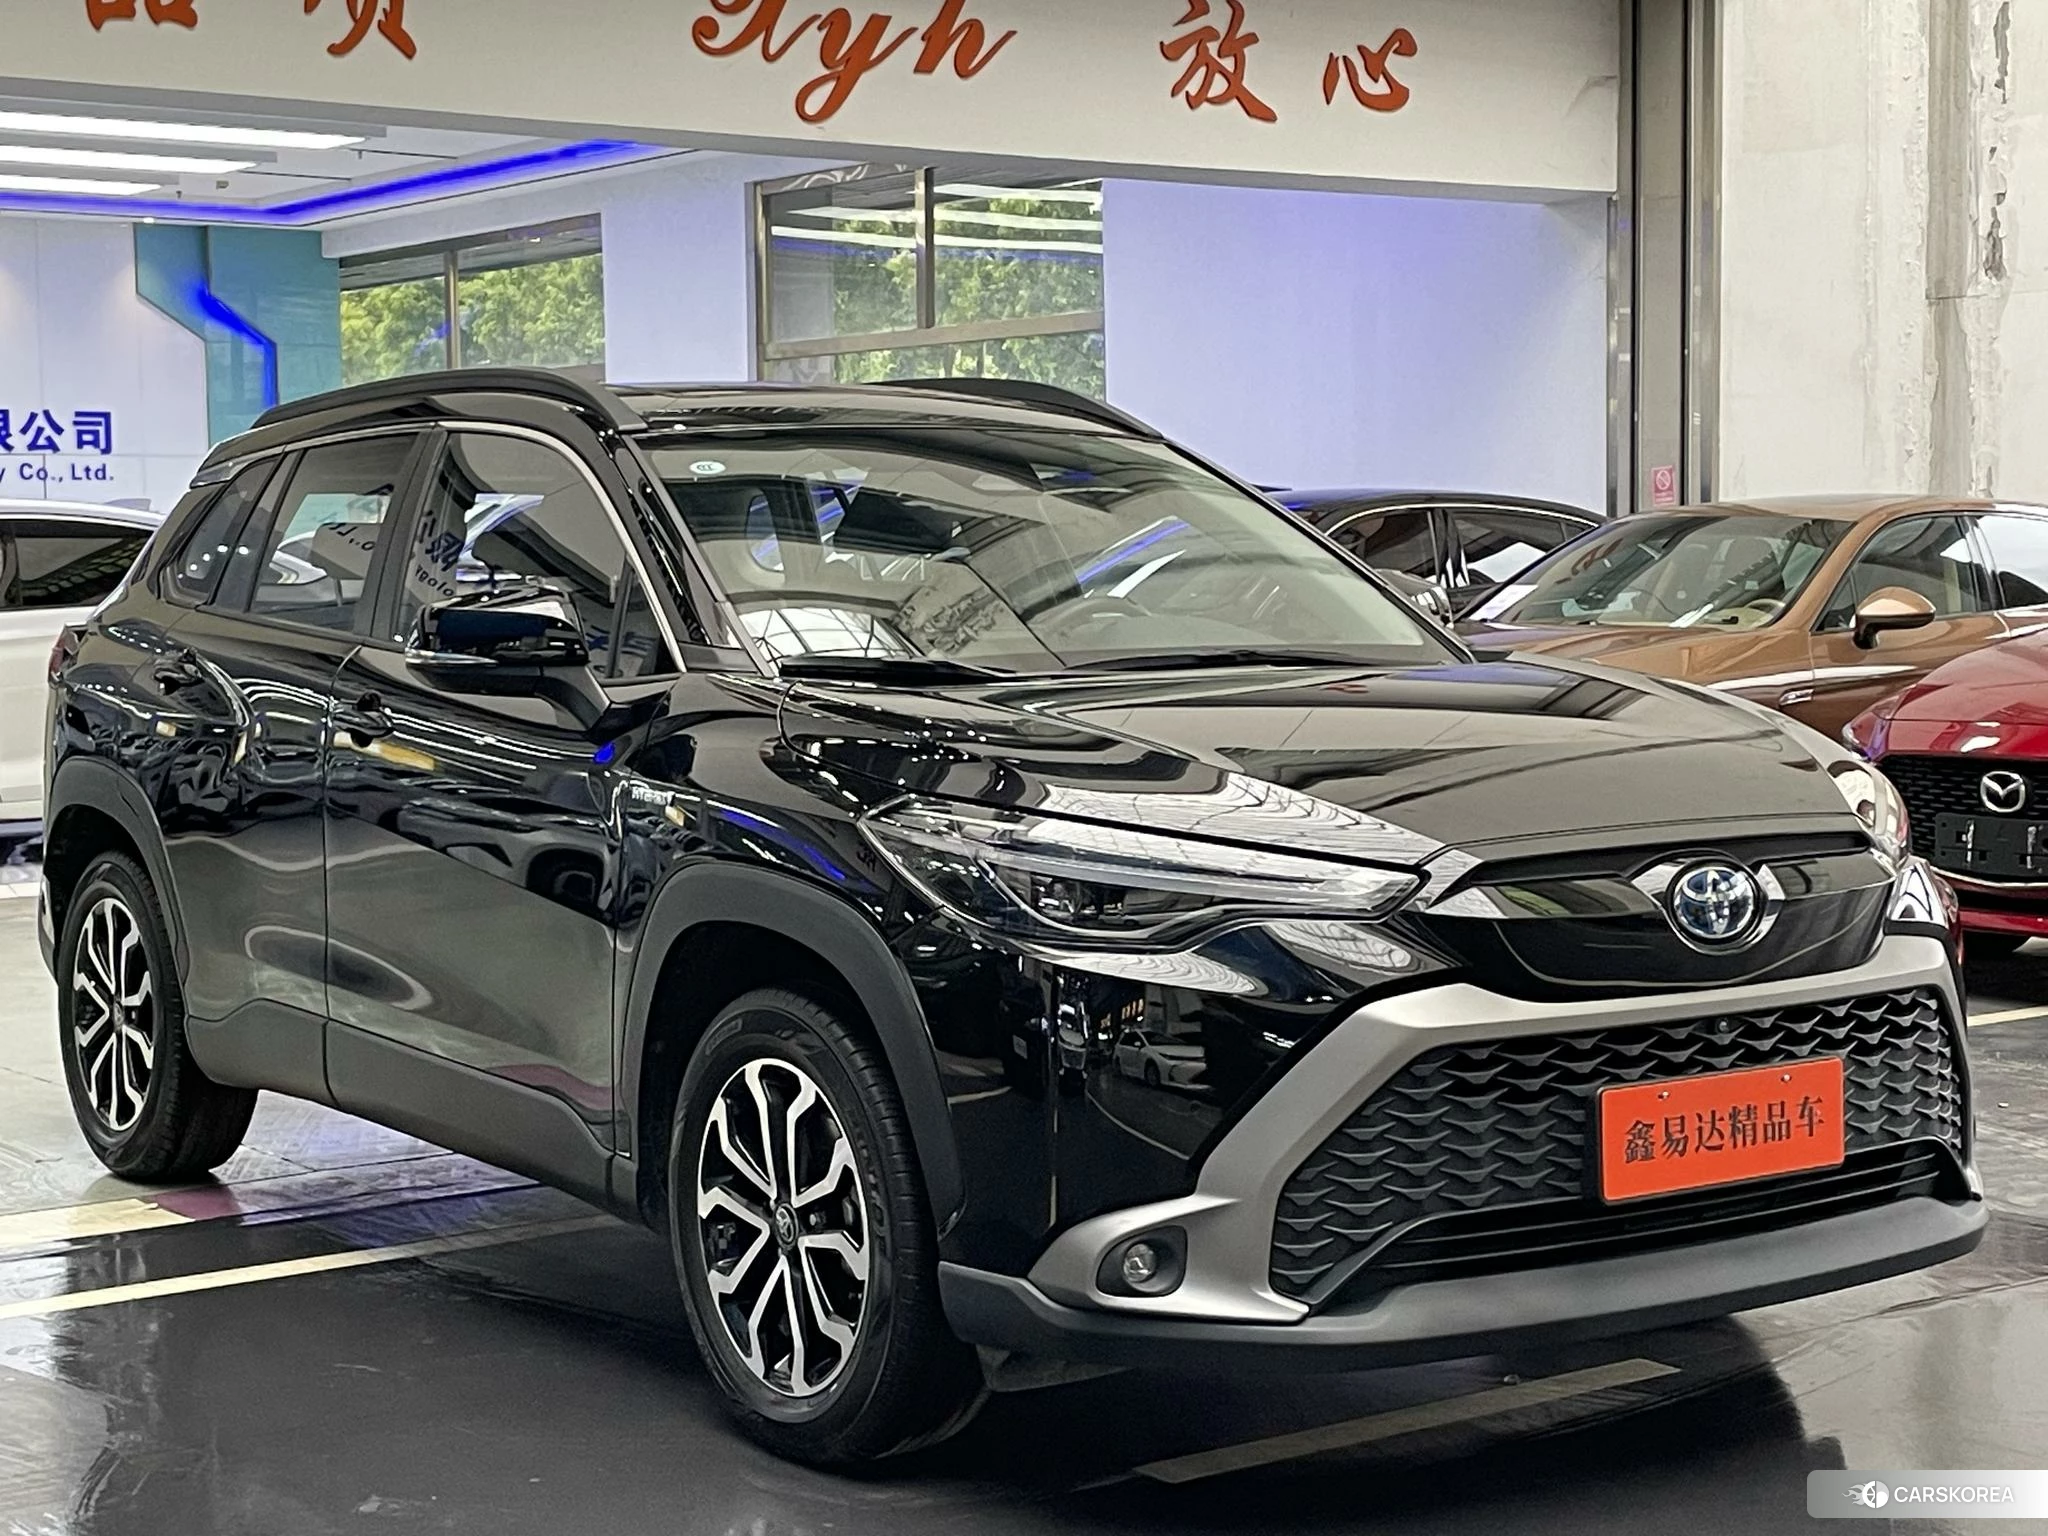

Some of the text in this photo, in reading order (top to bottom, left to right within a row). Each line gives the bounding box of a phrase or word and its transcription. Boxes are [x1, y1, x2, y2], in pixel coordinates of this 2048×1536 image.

[1158, 0, 1419, 123] 放心
[19, 462, 64, 483] Co.,
[70, 463, 115, 481] Ltd.
[1624, 1095, 1826, 1164] 鑫易达精品车
